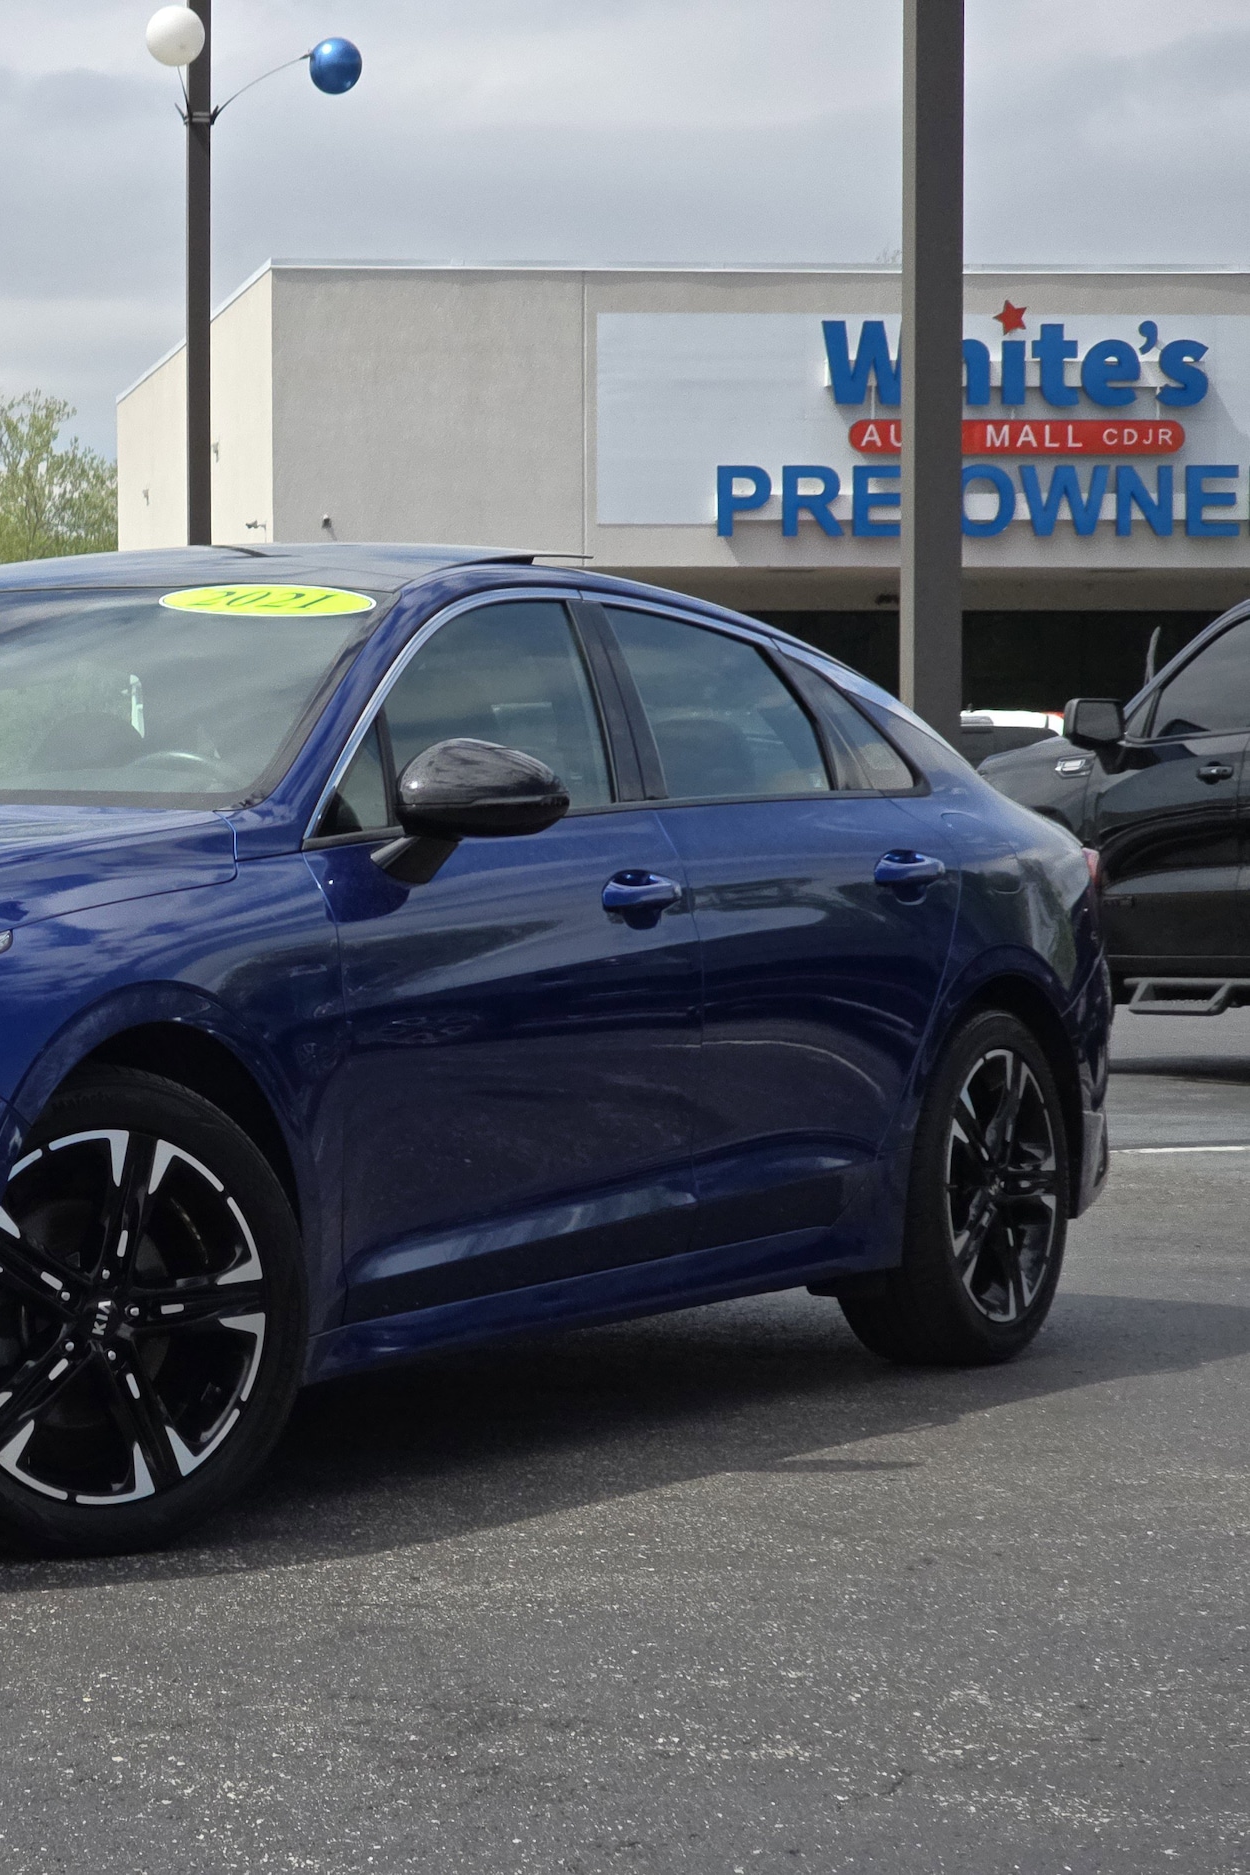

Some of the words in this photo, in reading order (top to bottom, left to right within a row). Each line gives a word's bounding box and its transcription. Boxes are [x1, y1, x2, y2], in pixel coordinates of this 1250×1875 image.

[986, 424, 1083, 448] MALL
[1103, 428, 1173, 446] CDJR
[187, 590, 340, 610] 2021
[91, 1300, 112, 1336] KIA
